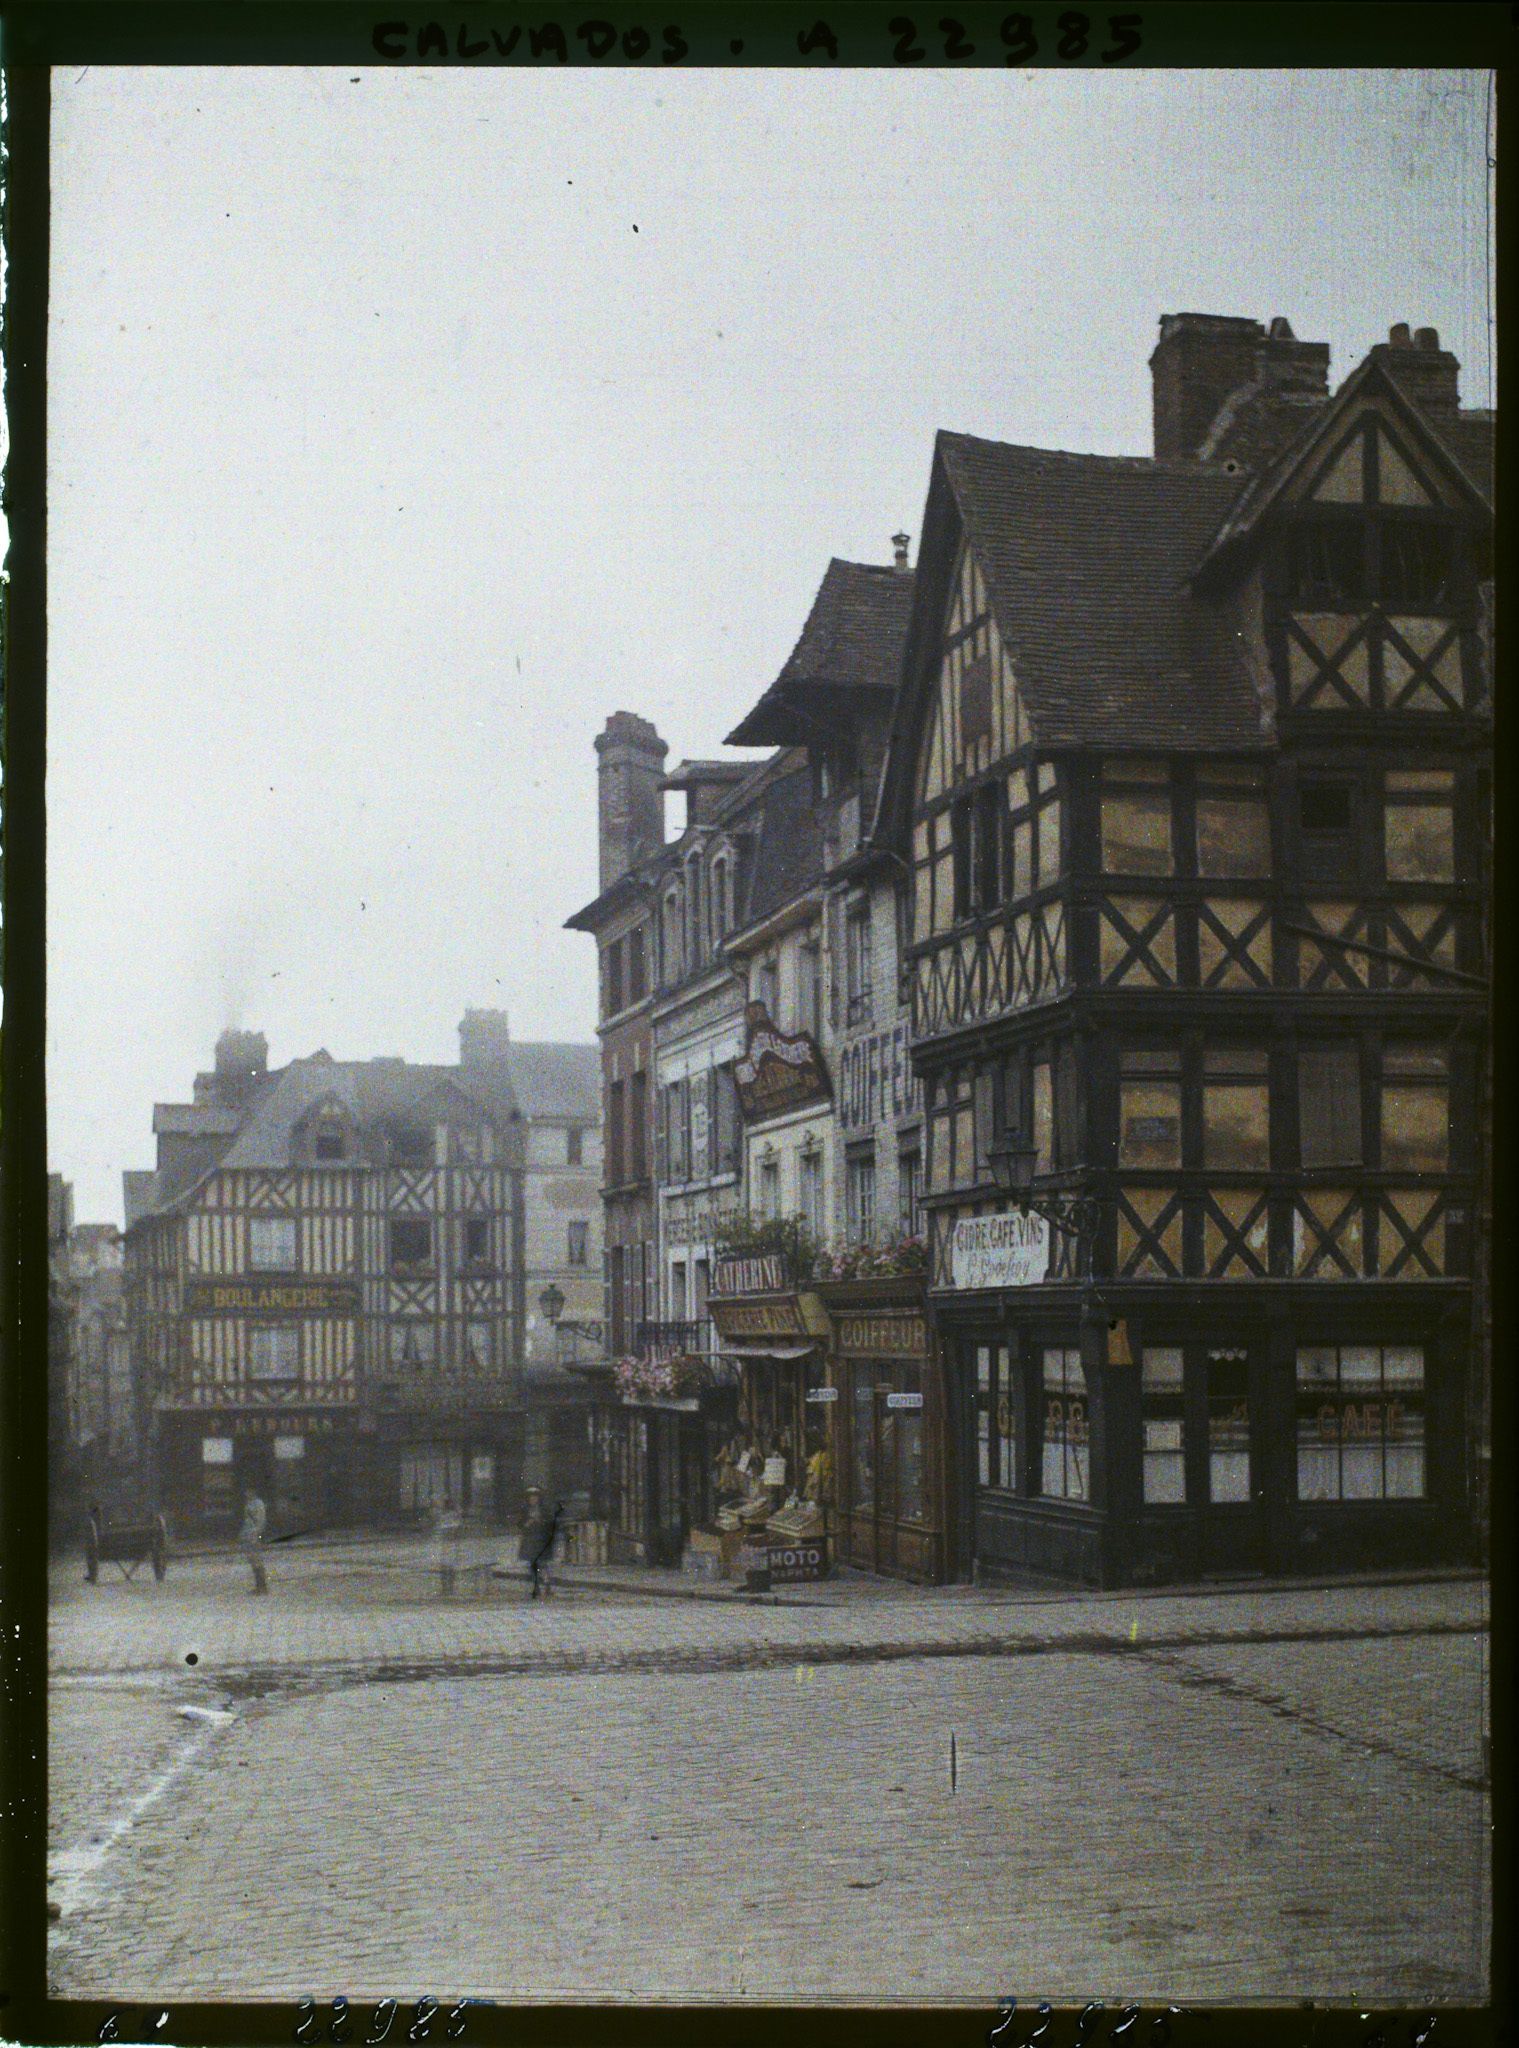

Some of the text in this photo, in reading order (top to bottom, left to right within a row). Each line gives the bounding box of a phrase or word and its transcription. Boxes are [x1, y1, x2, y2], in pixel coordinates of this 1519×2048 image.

[213, 1287, 328, 1309] BOULANGERIE
[840, 1319, 926, 1348] COIFFEUR
[770, 1549, 820, 1567] MOTO
